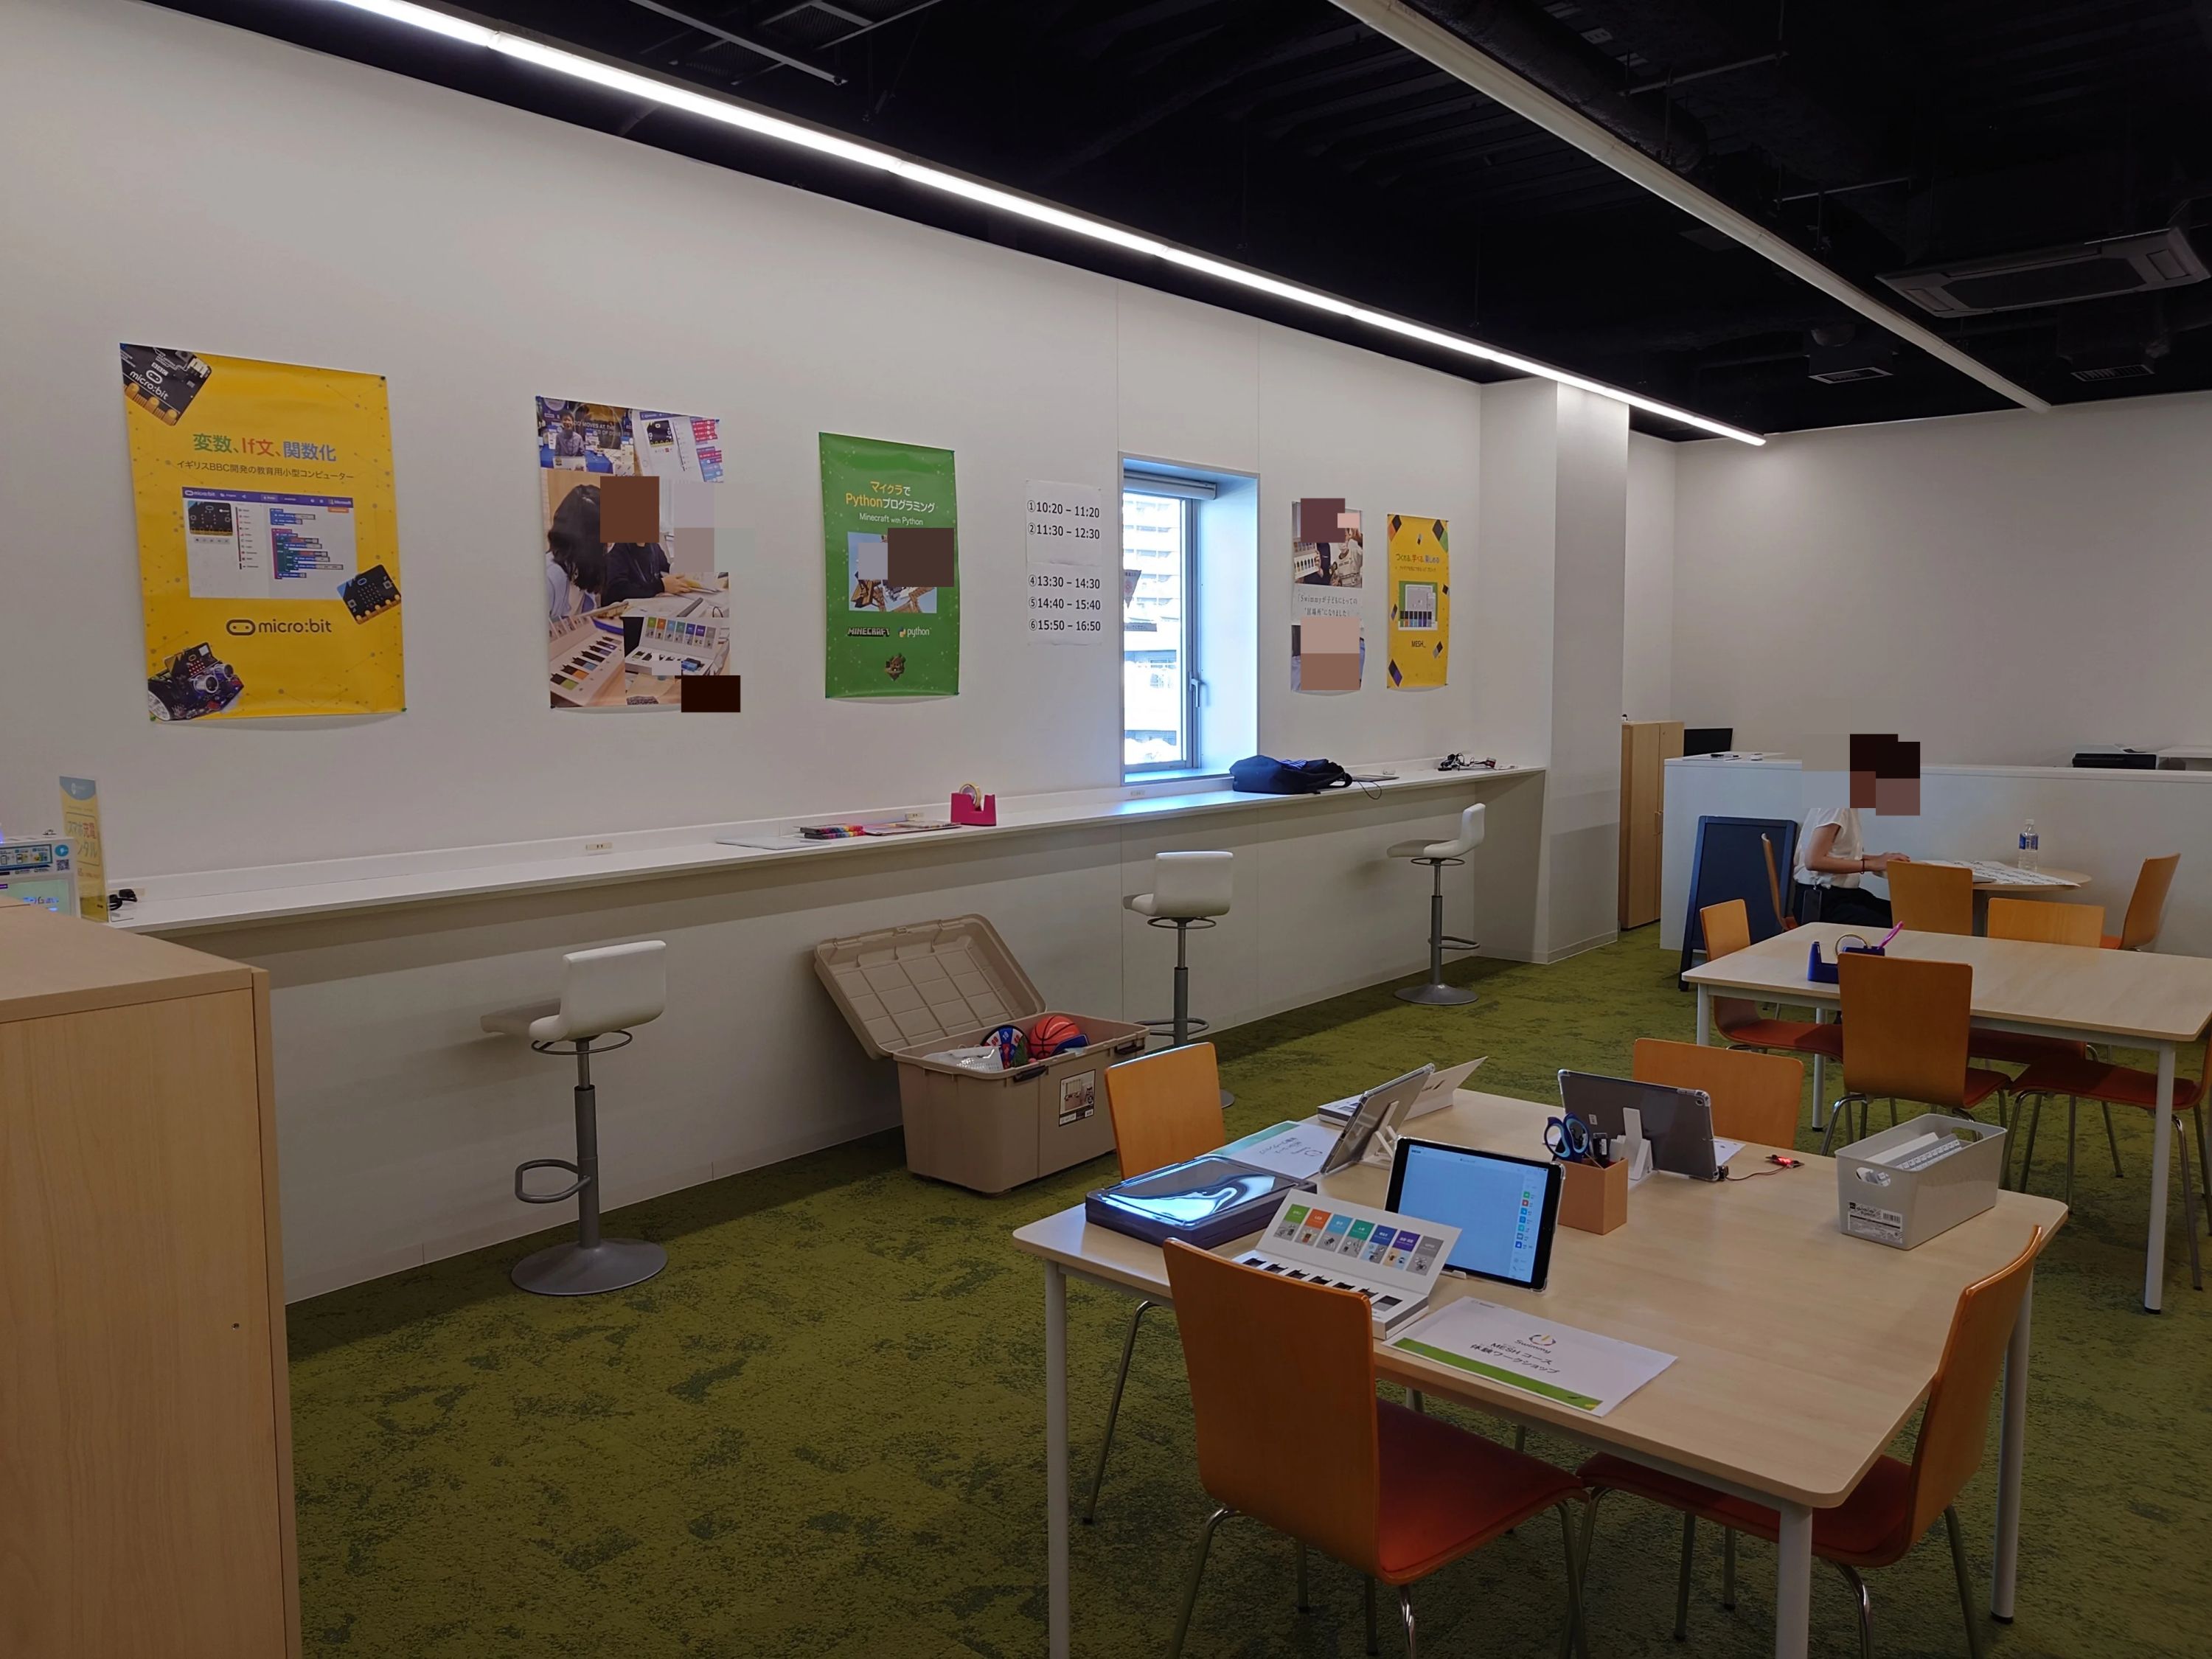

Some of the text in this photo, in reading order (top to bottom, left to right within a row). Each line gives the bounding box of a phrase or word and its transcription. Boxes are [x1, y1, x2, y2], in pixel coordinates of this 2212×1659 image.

[130, 371, 168, 400] micro:bit
[177, 459, 354, 481] イギリスBBC開発の教育用小型コンピューター
[870, 481, 911, 496] マイクラで
[846, 493, 936, 513] Pythonプログラミング
[859, 512, 890, 523] Minecraft
[902, 517, 923, 526] Python
[1074, 506, 1099, 518] 11:20
[1075, 528, 1100, 539] 12:30
[1075, 578, 1100, 589] 14:30
[1075, 599, 1101, 611] 15:40
[259, 618, 333, 633] micro:bit
[847, 627, 890, 637] MINECRAFT
[1076, 621, 1101, 632] 16:50
[1491, 1343, 1552, 1365] MESH コース
[1514, 1339, 1551, 1354] Swimmy
[1470, 1344, 1560, 1374] 体験ワークショップ
